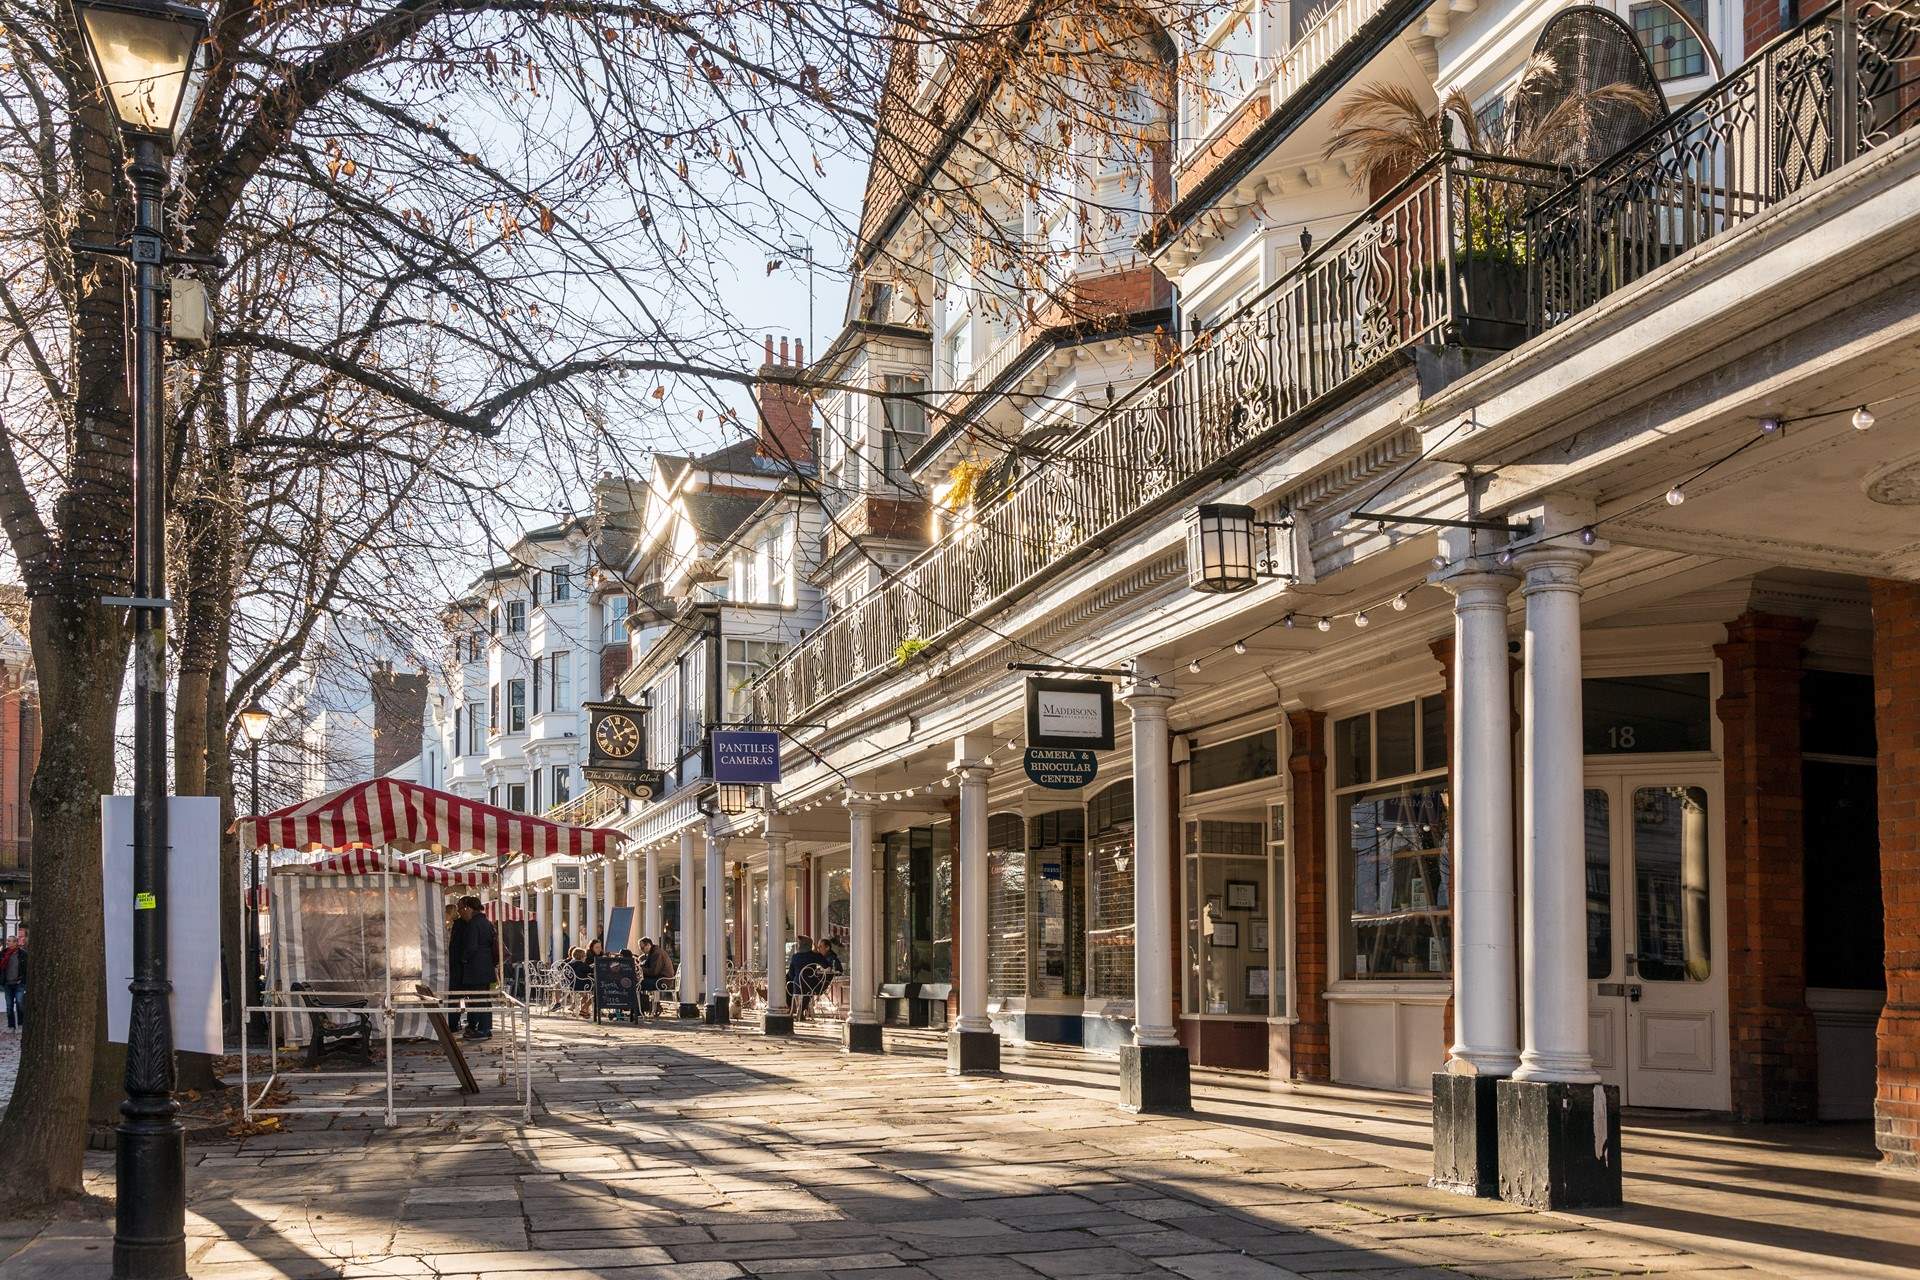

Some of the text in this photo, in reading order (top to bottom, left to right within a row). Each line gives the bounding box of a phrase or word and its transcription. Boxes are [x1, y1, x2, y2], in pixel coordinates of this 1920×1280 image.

[1043, 704, 1098, 717] MADDISONS
[1608, 726, 1636, 749] 18
[719, 743, 775, 754] PANTILES
[720, 755, 774, 765] CAMERAS
[1030, 750, 1089, 760] CAMERA &
[1030, 762, 1091, 772] BINOCULAR
[585, 770, 601, 779] The
[639, 773, 660, 782] Clock
[1040, 774, 1083, 784] CENTRE
